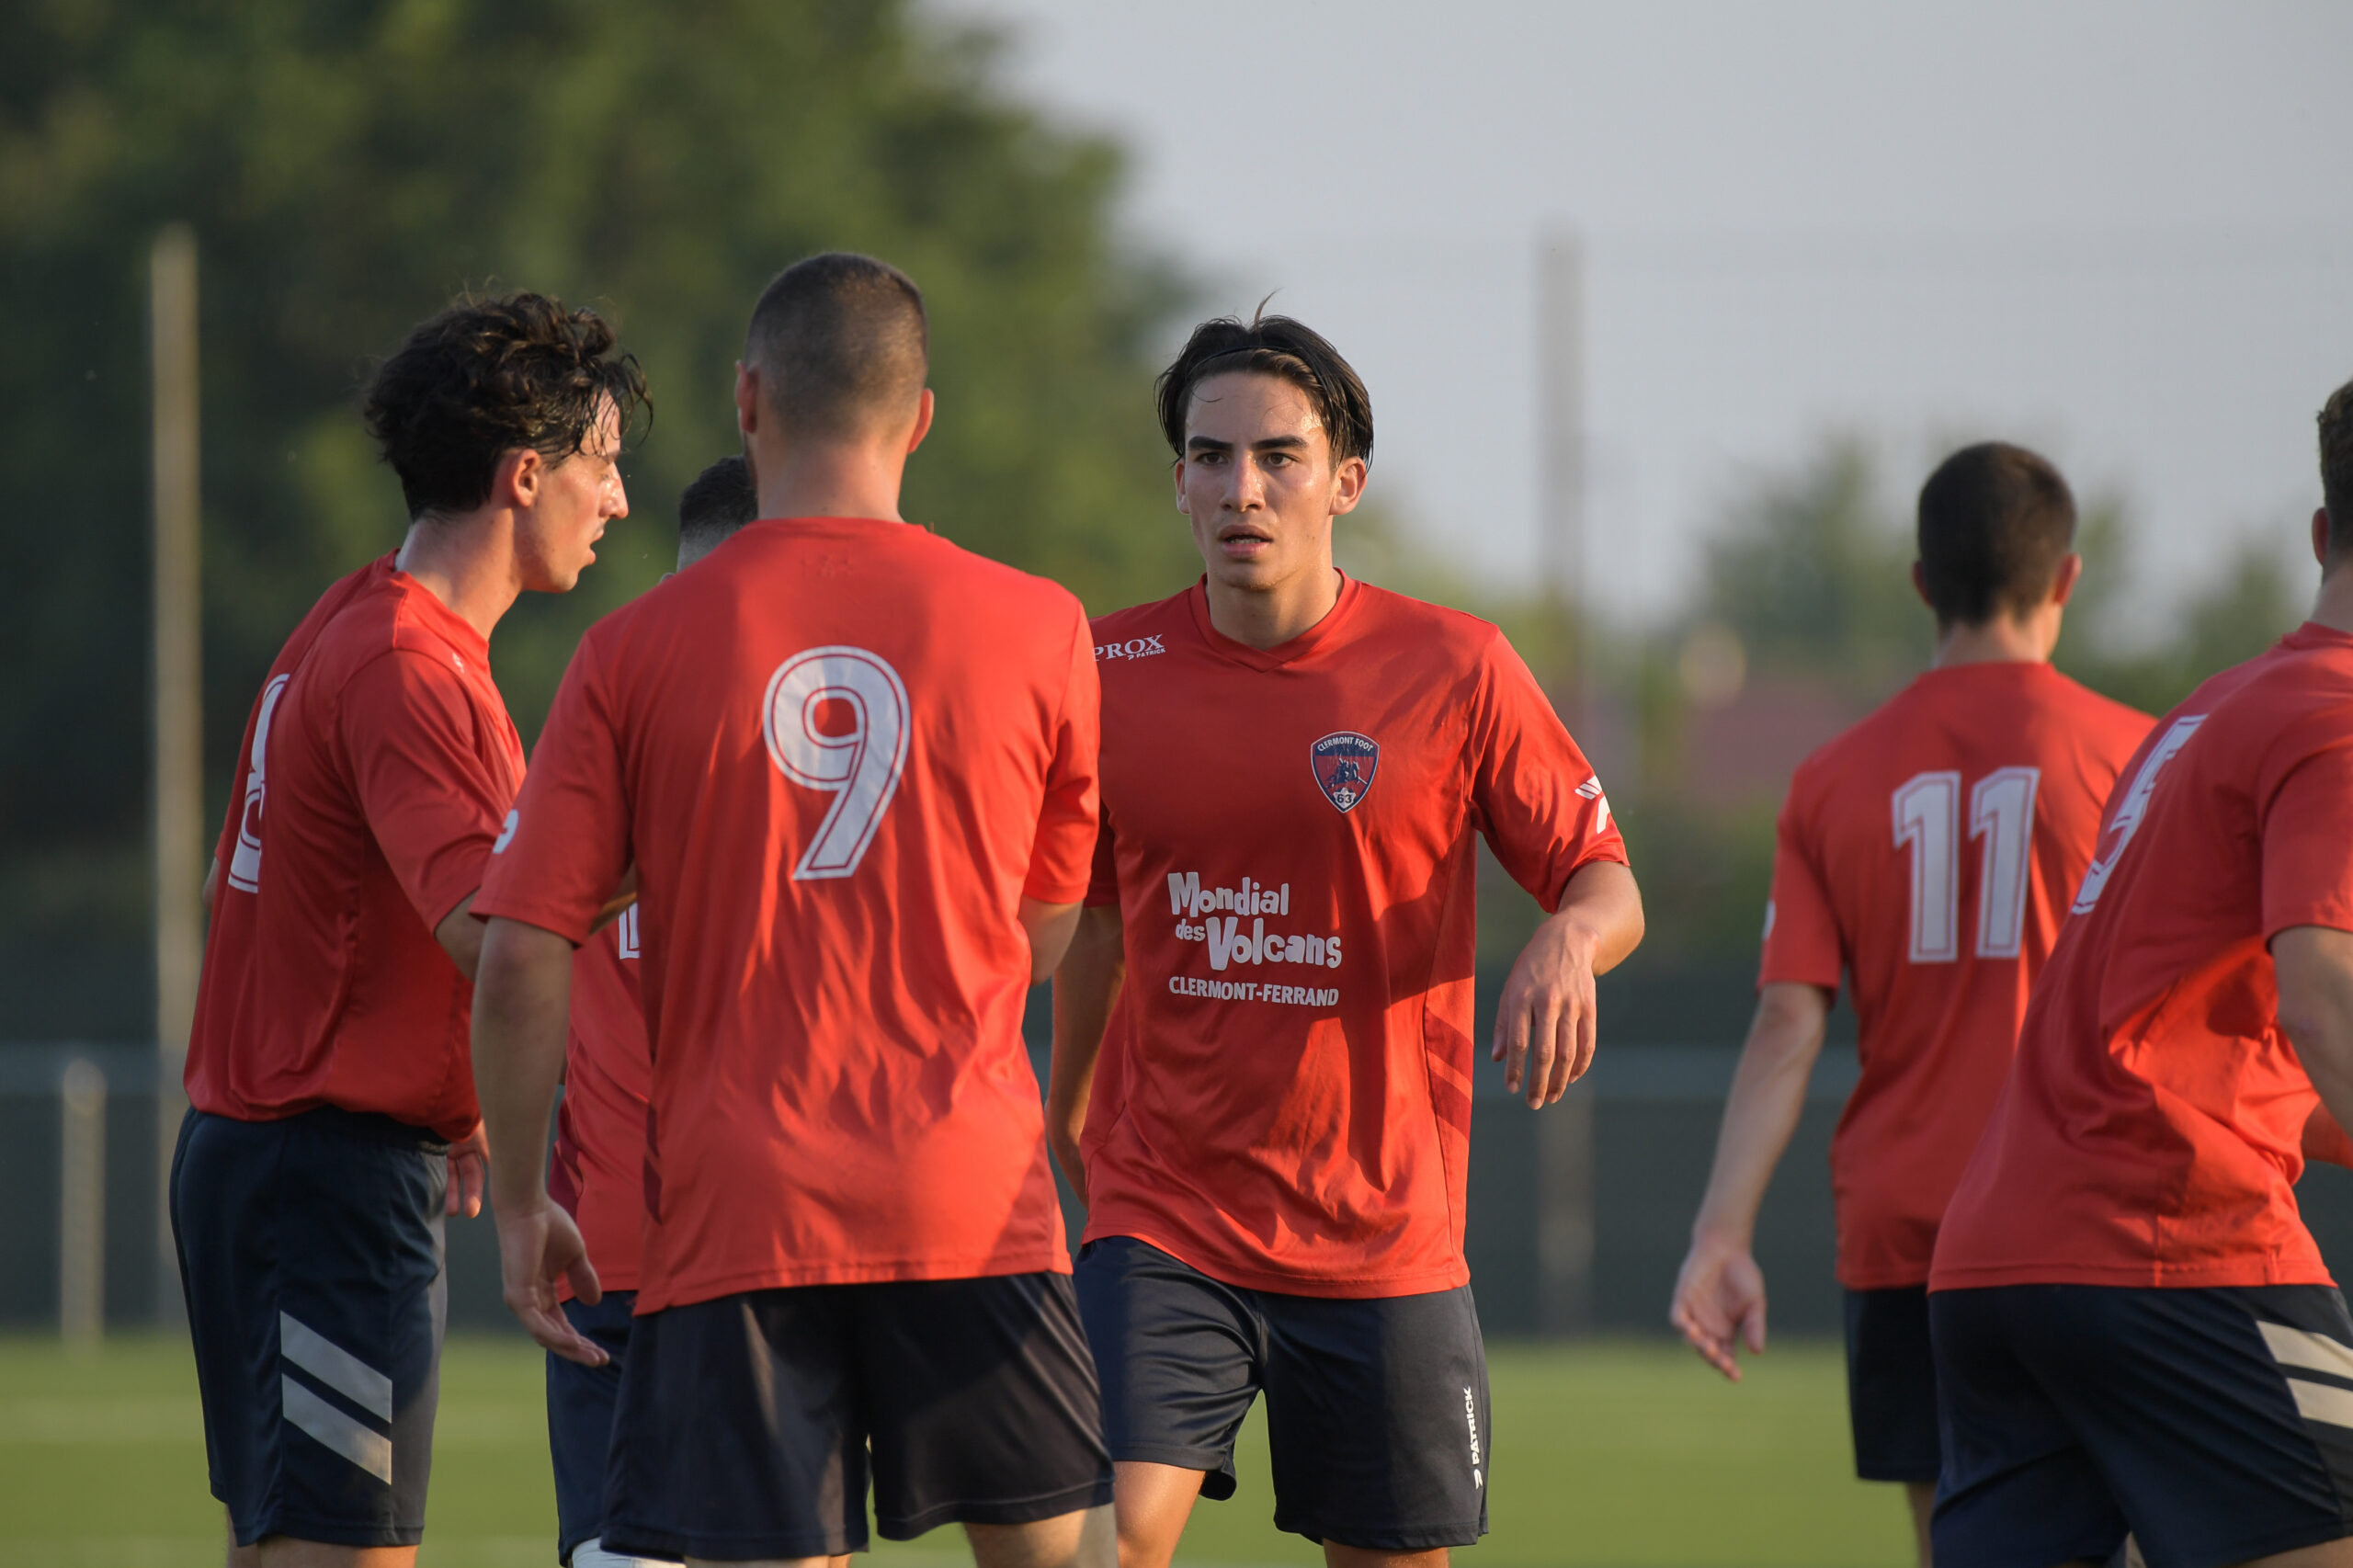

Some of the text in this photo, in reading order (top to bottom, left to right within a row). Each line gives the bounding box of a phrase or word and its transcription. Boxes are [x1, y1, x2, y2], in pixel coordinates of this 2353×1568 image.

[1136, 647, 1165, 658] PATRICK
[762, 644, 911, 881] 9
[1317, 736, 1374, 752] CLERMONT FOOT
[1336, 794, 1352, 804] 63
[1892, 766, 2041, 963] 11
[1167, 871, 1289, 917] Mondial
[1176, 916, 1342, 971] des Volcans
[1168, 976, 1339, 1006] CLERMONT-FERRAND
[1463, 1385, 1480, 1465] PATRICK
